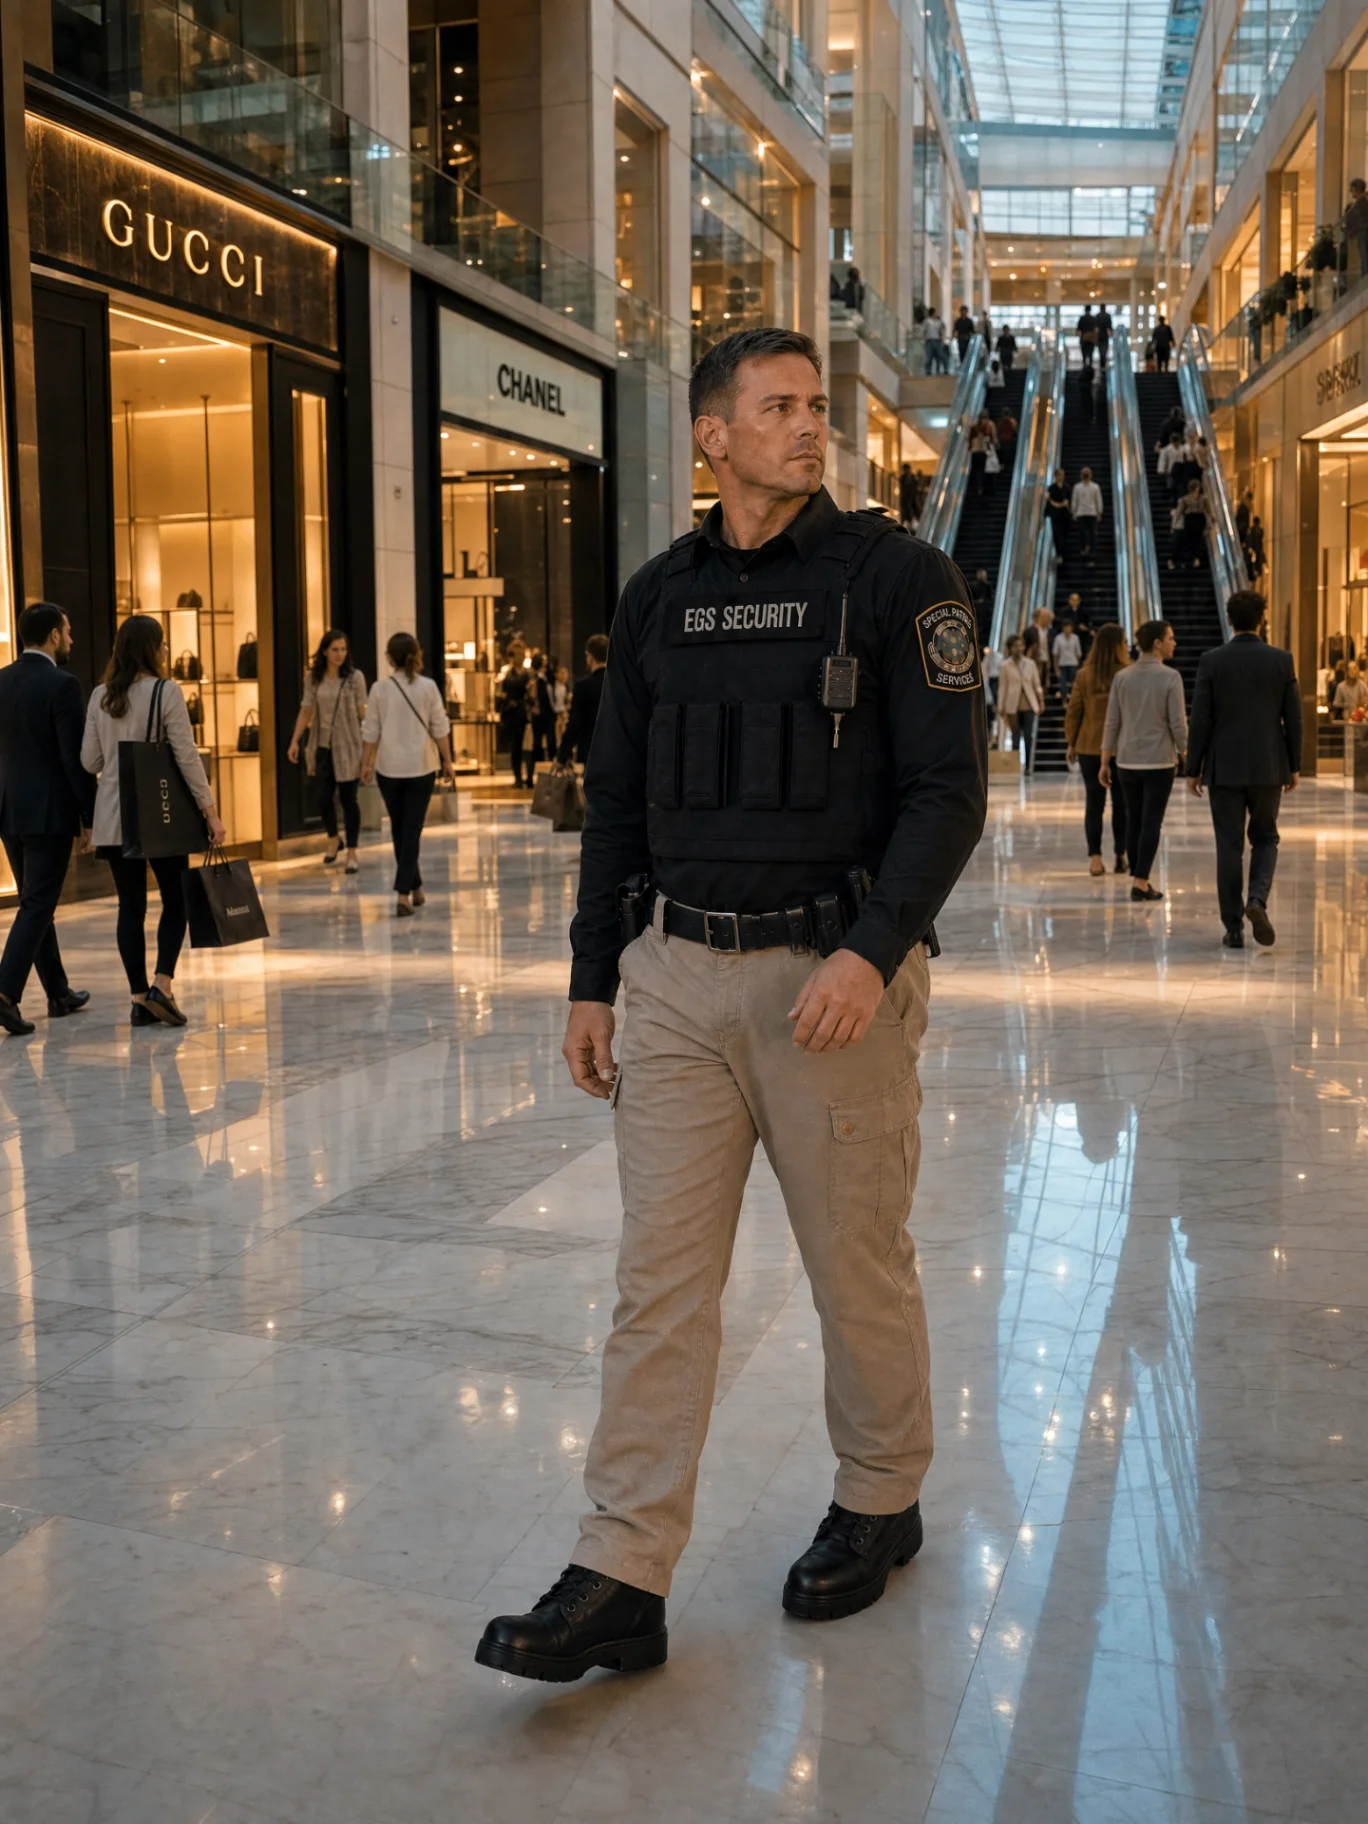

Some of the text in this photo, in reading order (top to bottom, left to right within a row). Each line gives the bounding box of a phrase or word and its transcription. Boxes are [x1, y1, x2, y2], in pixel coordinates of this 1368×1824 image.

[103, 199, 264, 297] GUCCI
[497, 363, 566, 418] CHANEL
[684, 602, 808, 633] EGS SECURITY
[922, 607, 951, 629] SPECIAL
[936, 672, 975, 686] SERVICES
